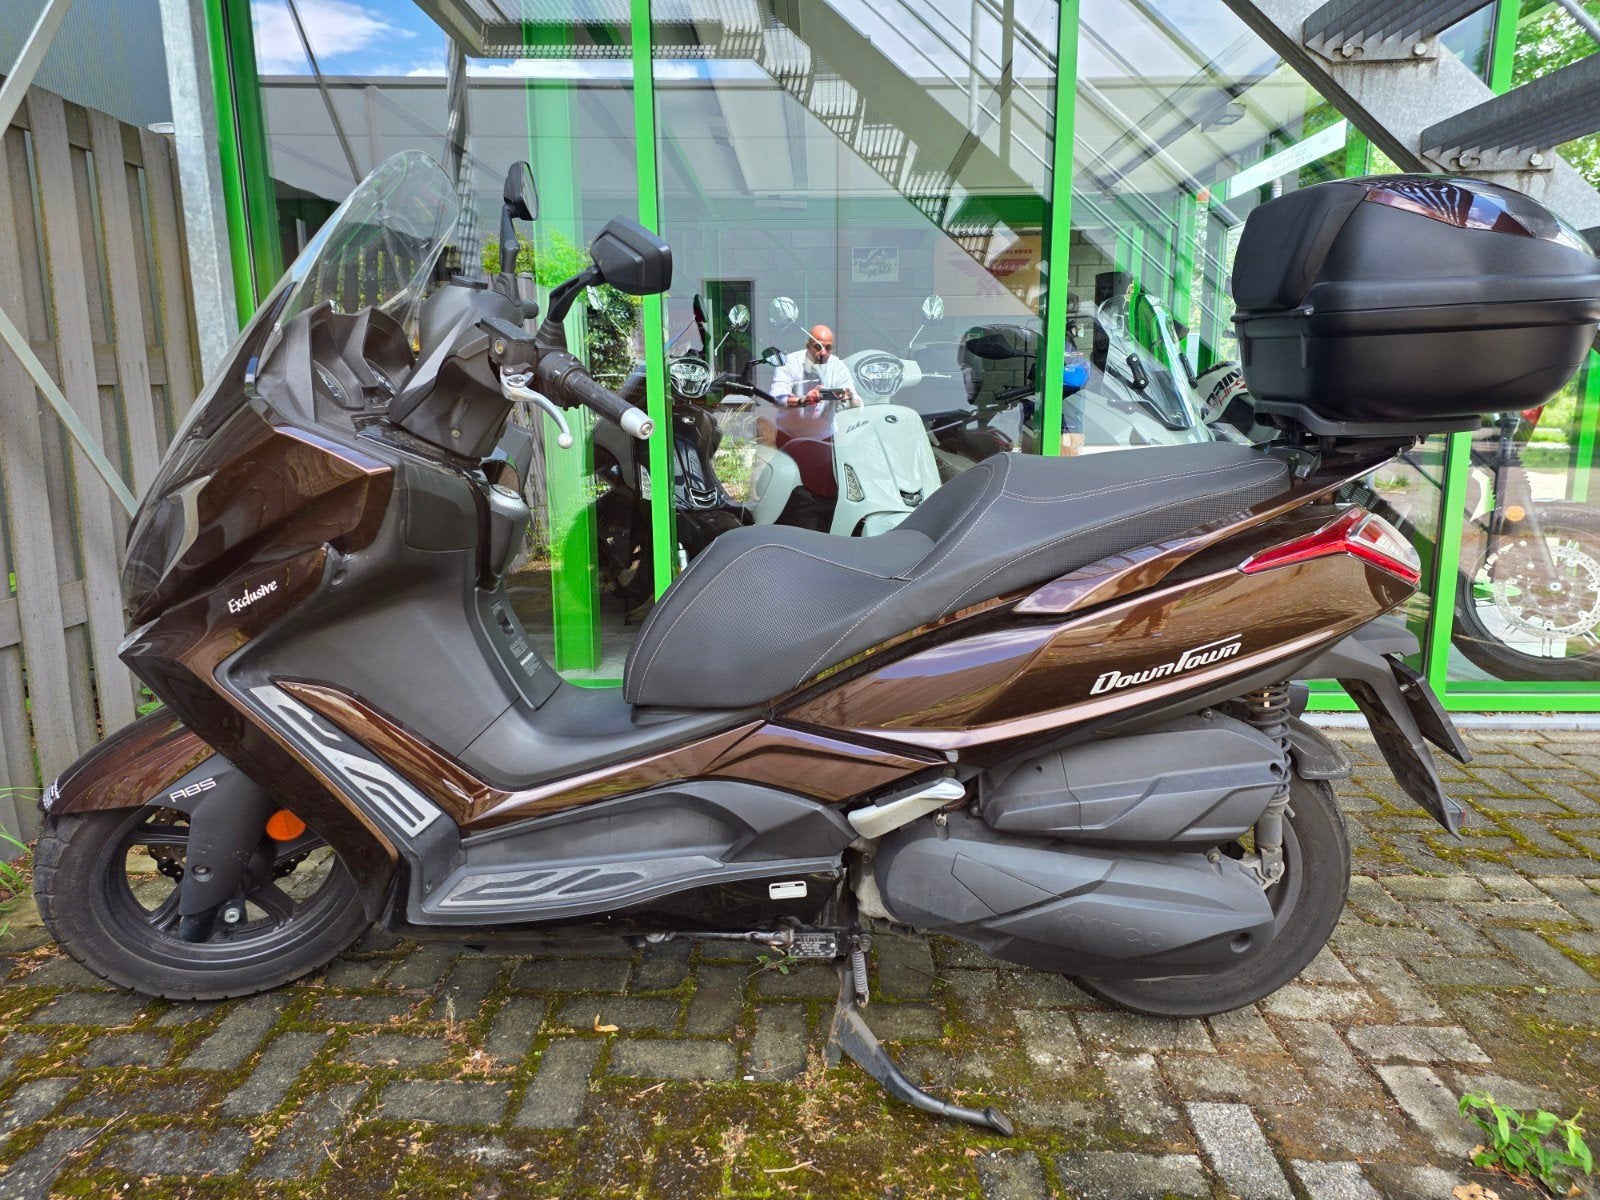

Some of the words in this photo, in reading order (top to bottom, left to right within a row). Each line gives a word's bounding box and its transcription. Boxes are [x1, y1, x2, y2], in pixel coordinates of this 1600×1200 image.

[227, 580, 278, 614] Exclusive
[1089, 633, 1243, 695] DownTown
[169, 777, 217, 803] ABS
[1056, 910, 1168, 950] KYMCO
